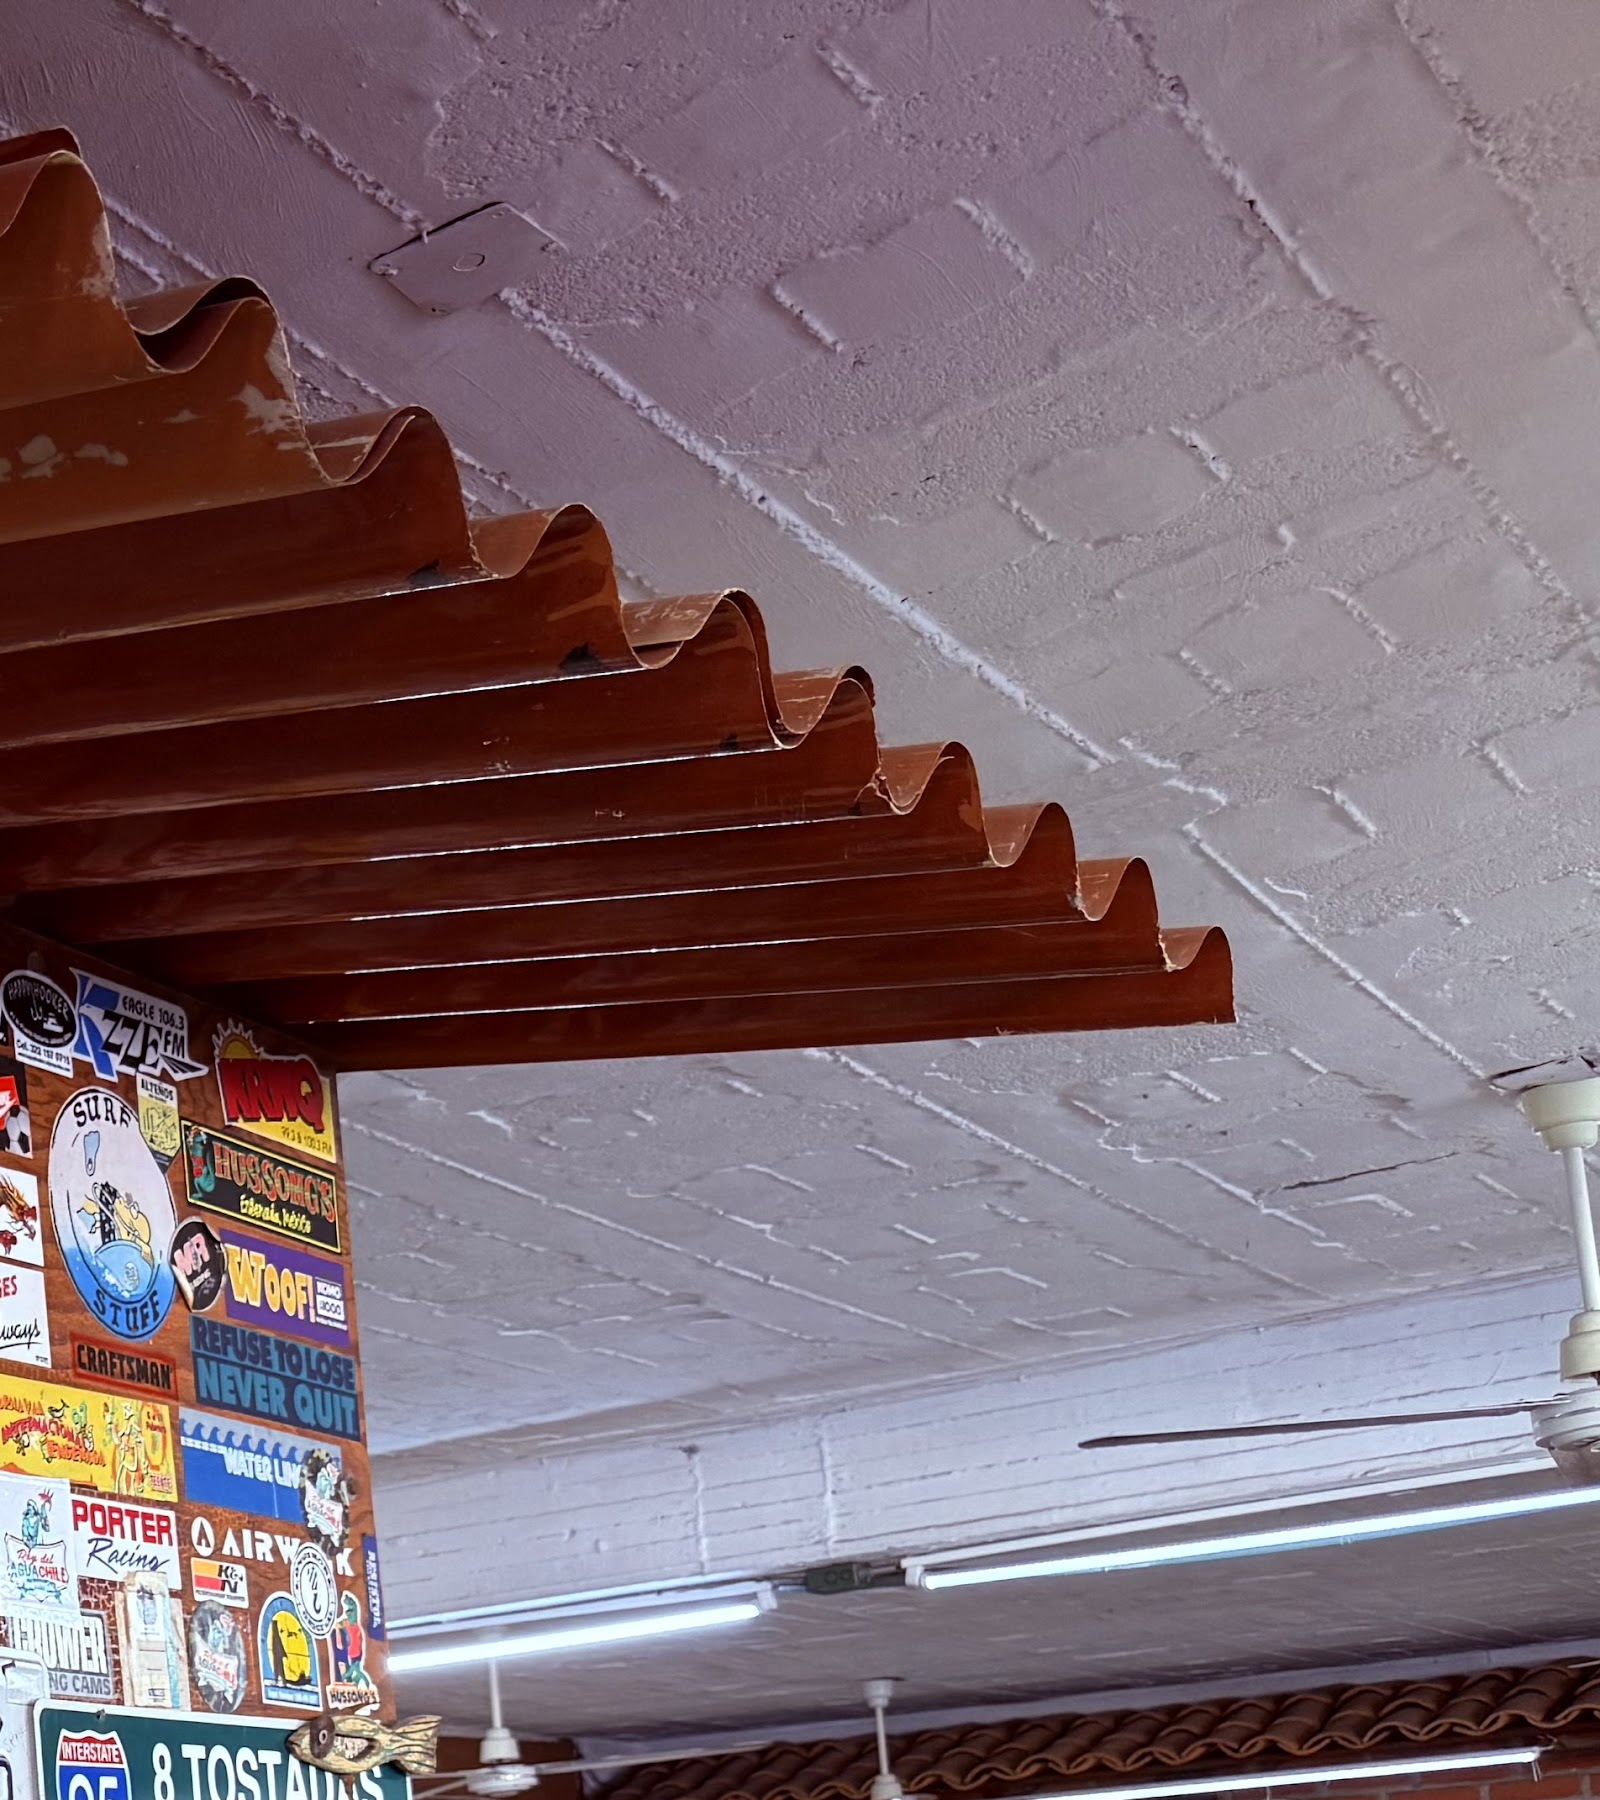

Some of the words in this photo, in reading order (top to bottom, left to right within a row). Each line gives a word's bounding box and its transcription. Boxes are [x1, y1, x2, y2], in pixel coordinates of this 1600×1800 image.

[122, 996, 155, 1021] EAGLE
[164, 1029, 185, 1059] FM
[73, 1095, 131, 1129] SURF
[213, 1142, 335, 1223] HUSSONG'S
[225, 1243, 317, 1324] WOOF!
[93, 1290, 162, 1331] STUFF
[77, 1344, 173, 1390] CRAFTSMAN
[193, 1318, 273, 1369] REFUSE
[274, 1338, 300, 1377] TO
[303, 1347, 355, 1389] LOSE
[196, 1357, 288, 1418] NEVER
[294, 1383, 360, 1435] QUIT
[223, 1448, 274, 1483] WATER
[73, 1501, 174, 1547] PORTER
[87, 1537, 170, 1574] Racing
[60, 1740, 120, 1765] INTERSTATE
